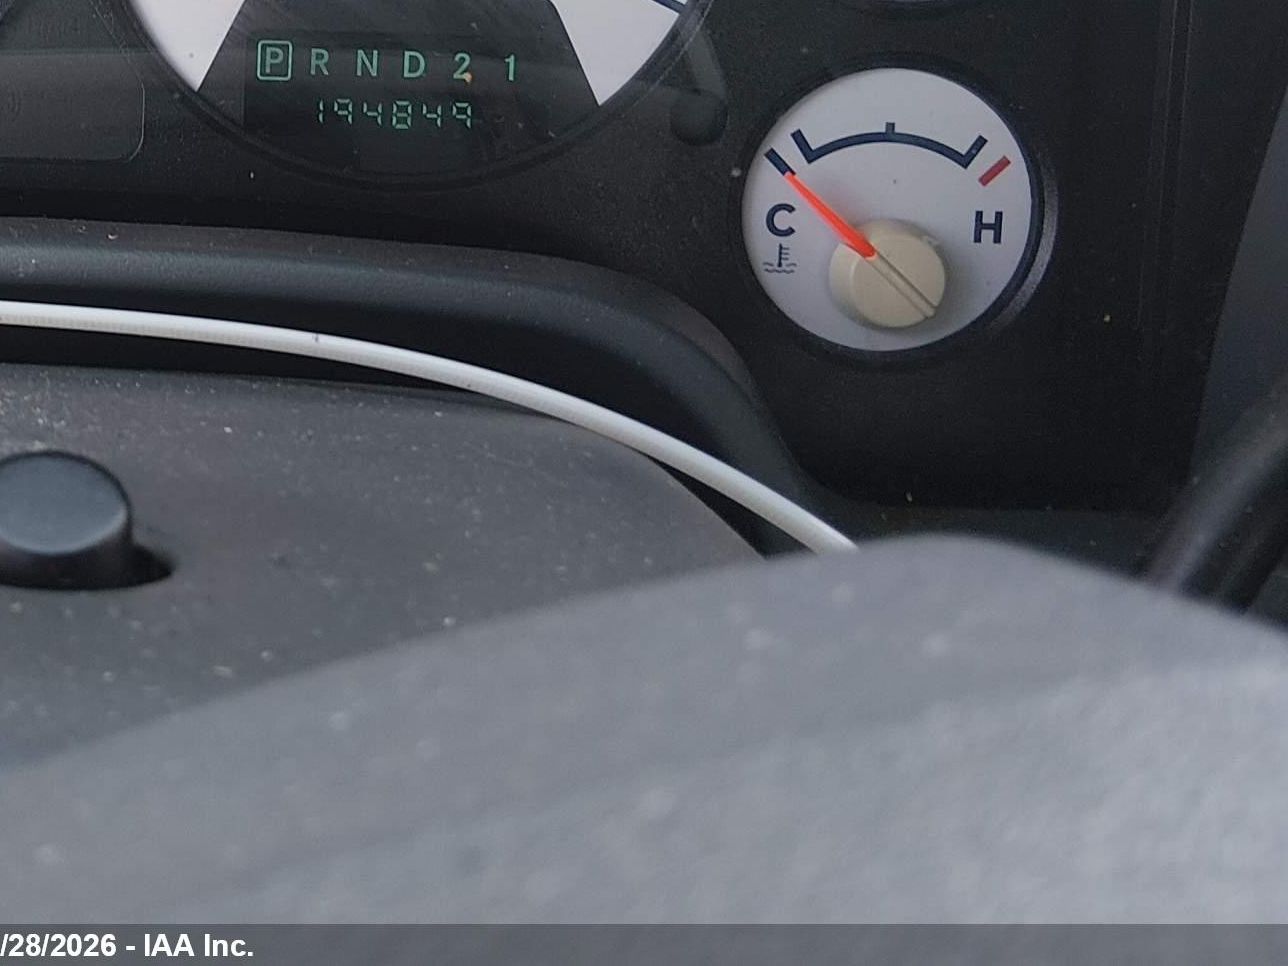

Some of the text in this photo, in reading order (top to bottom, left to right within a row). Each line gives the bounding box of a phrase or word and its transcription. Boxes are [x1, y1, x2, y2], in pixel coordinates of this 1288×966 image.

[265, 46, 515, 82] P R N D 2 1
[318, 98, 472, 130] 194849
[765, 203, 796, 238] C
[973, 210, 1004, 245] H
